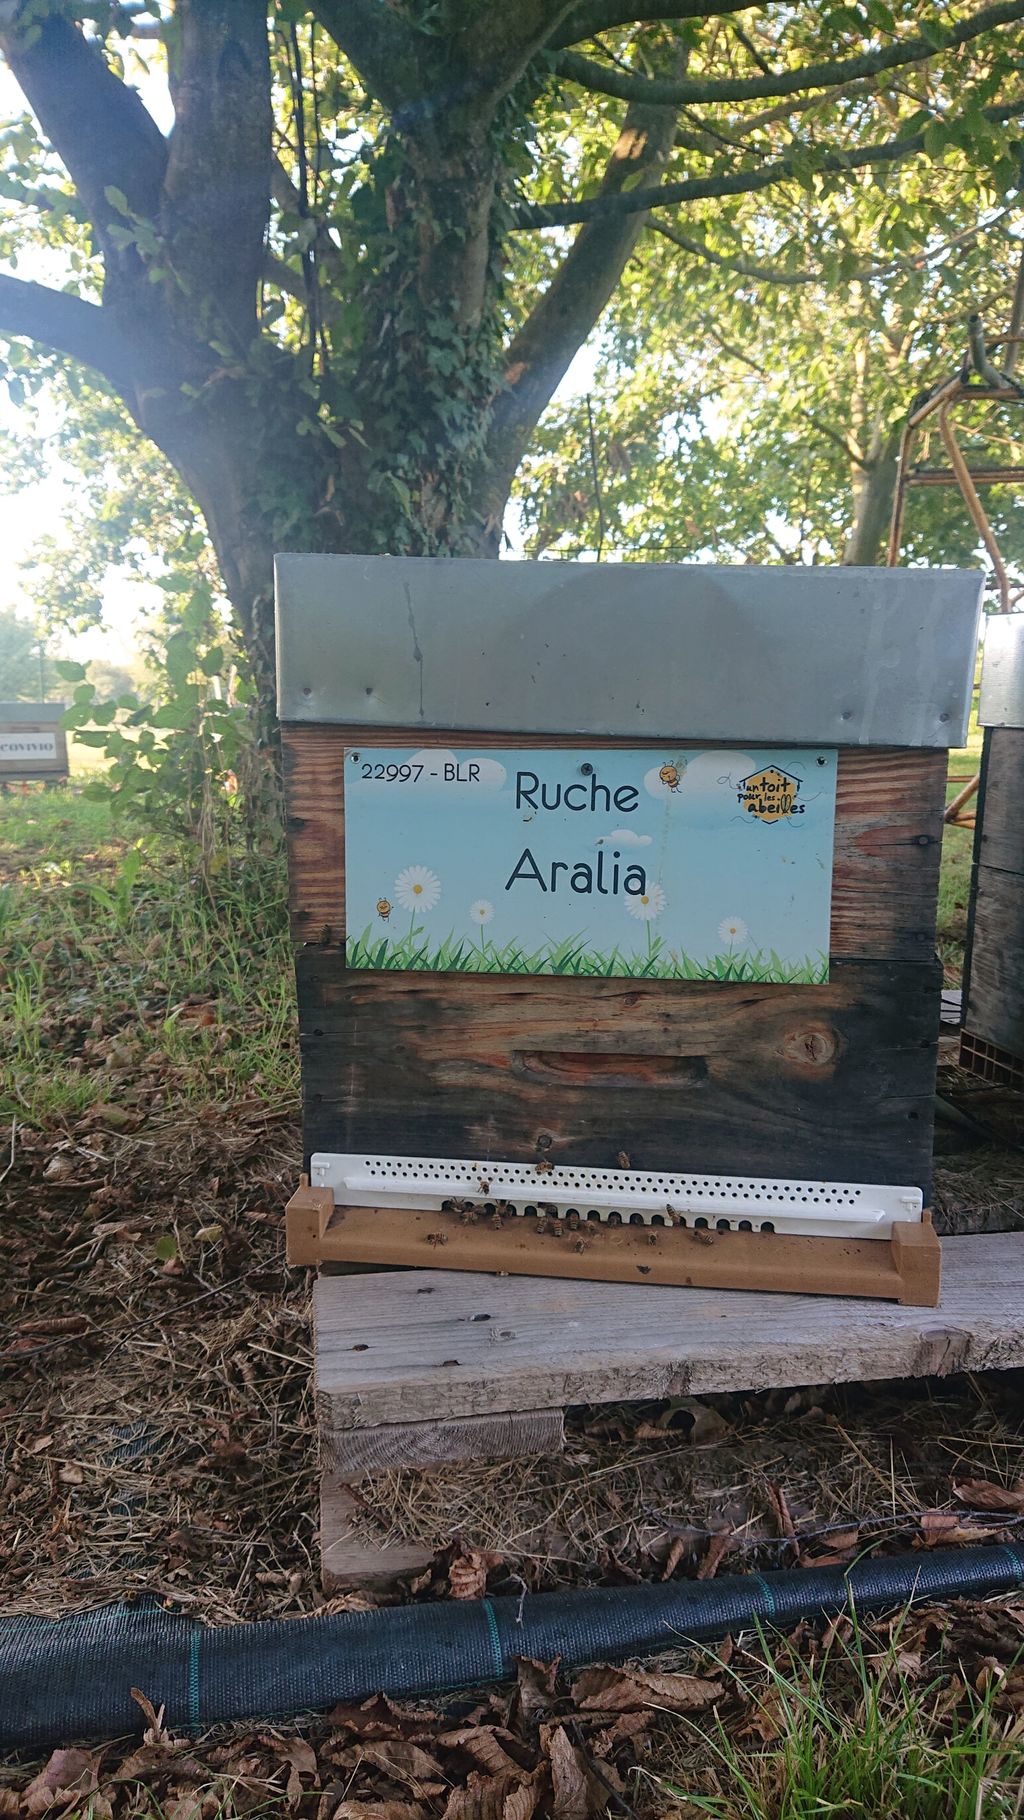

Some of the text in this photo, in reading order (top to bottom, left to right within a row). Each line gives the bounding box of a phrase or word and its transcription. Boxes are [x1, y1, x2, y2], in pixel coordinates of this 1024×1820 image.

[361, 763, 424, 783] 22997
[444, 763, 480, 782] BLR
[516, 771, 639, 812] Ruche
[760, 776, 791, 792] toit
[737, 793, 775, 803] pour les
[748, 794, 805, 814] abeilles
[505, 848, 646, 895] Aralia
